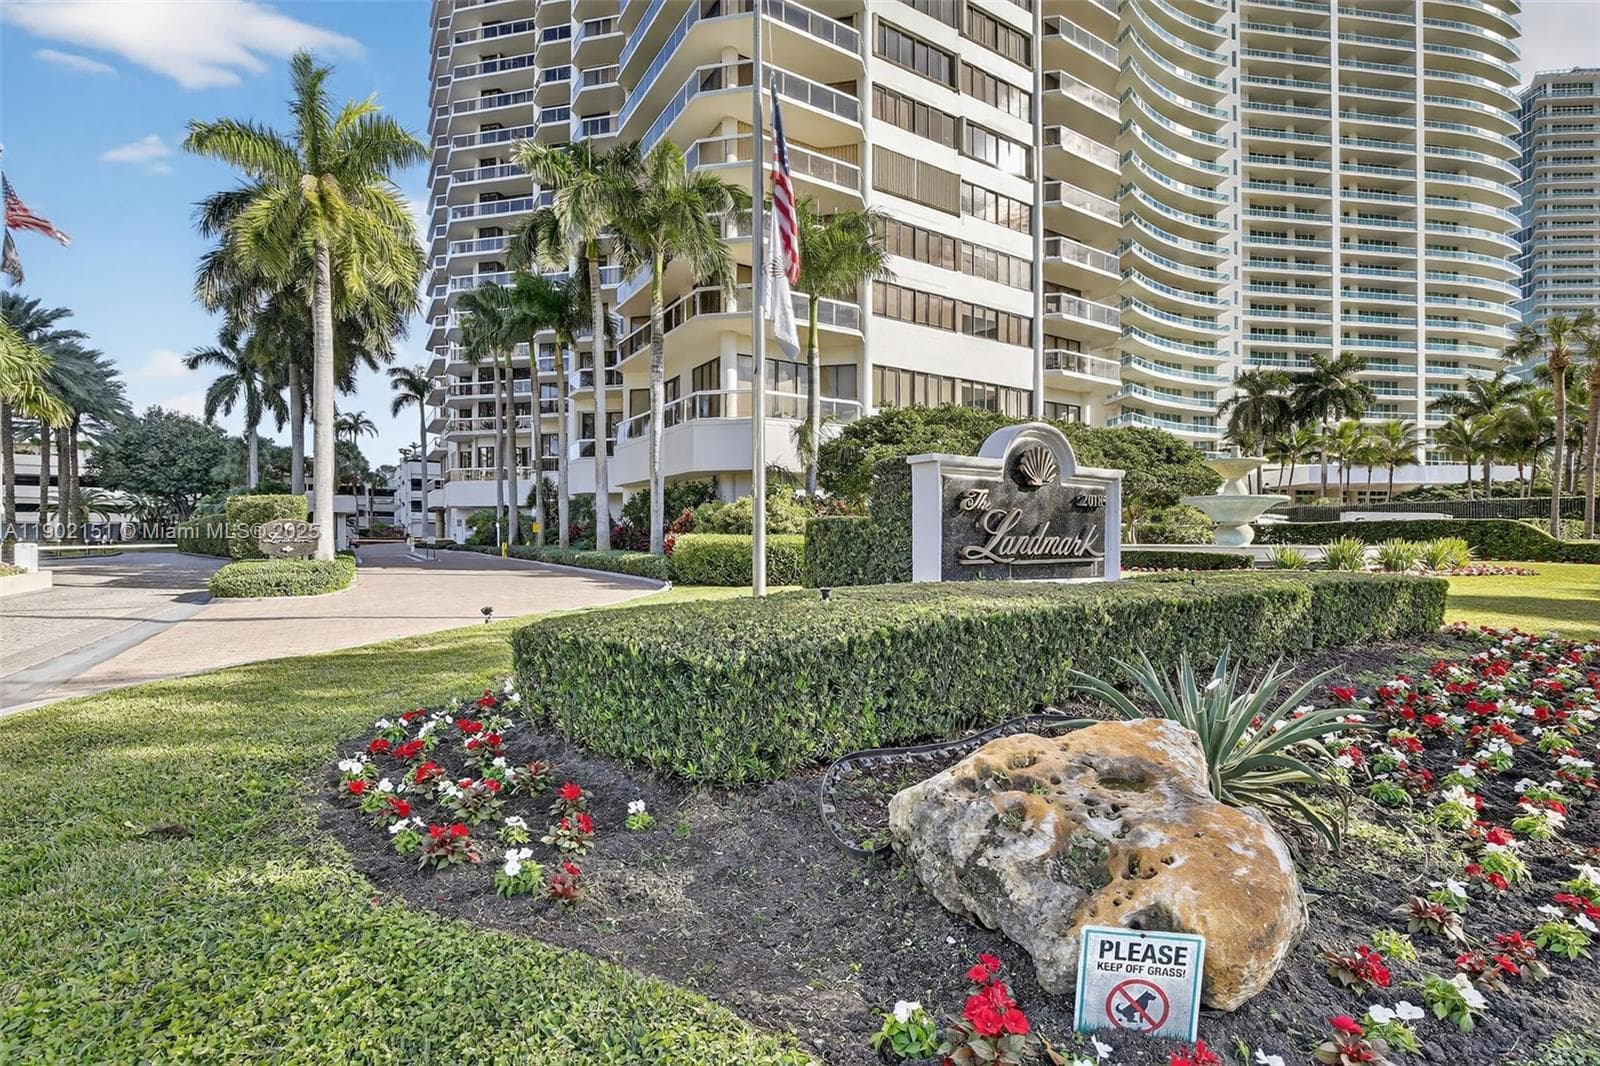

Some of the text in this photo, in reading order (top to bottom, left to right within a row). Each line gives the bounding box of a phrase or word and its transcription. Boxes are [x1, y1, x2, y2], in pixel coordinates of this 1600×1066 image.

[960, 488, 993, 511] The
[960, 508, 1104, 562] Landmark
[1099, 939, 1188, 966] PLEASE
[1097, 961, 1186, 978] KEEP OFF GRASS!
